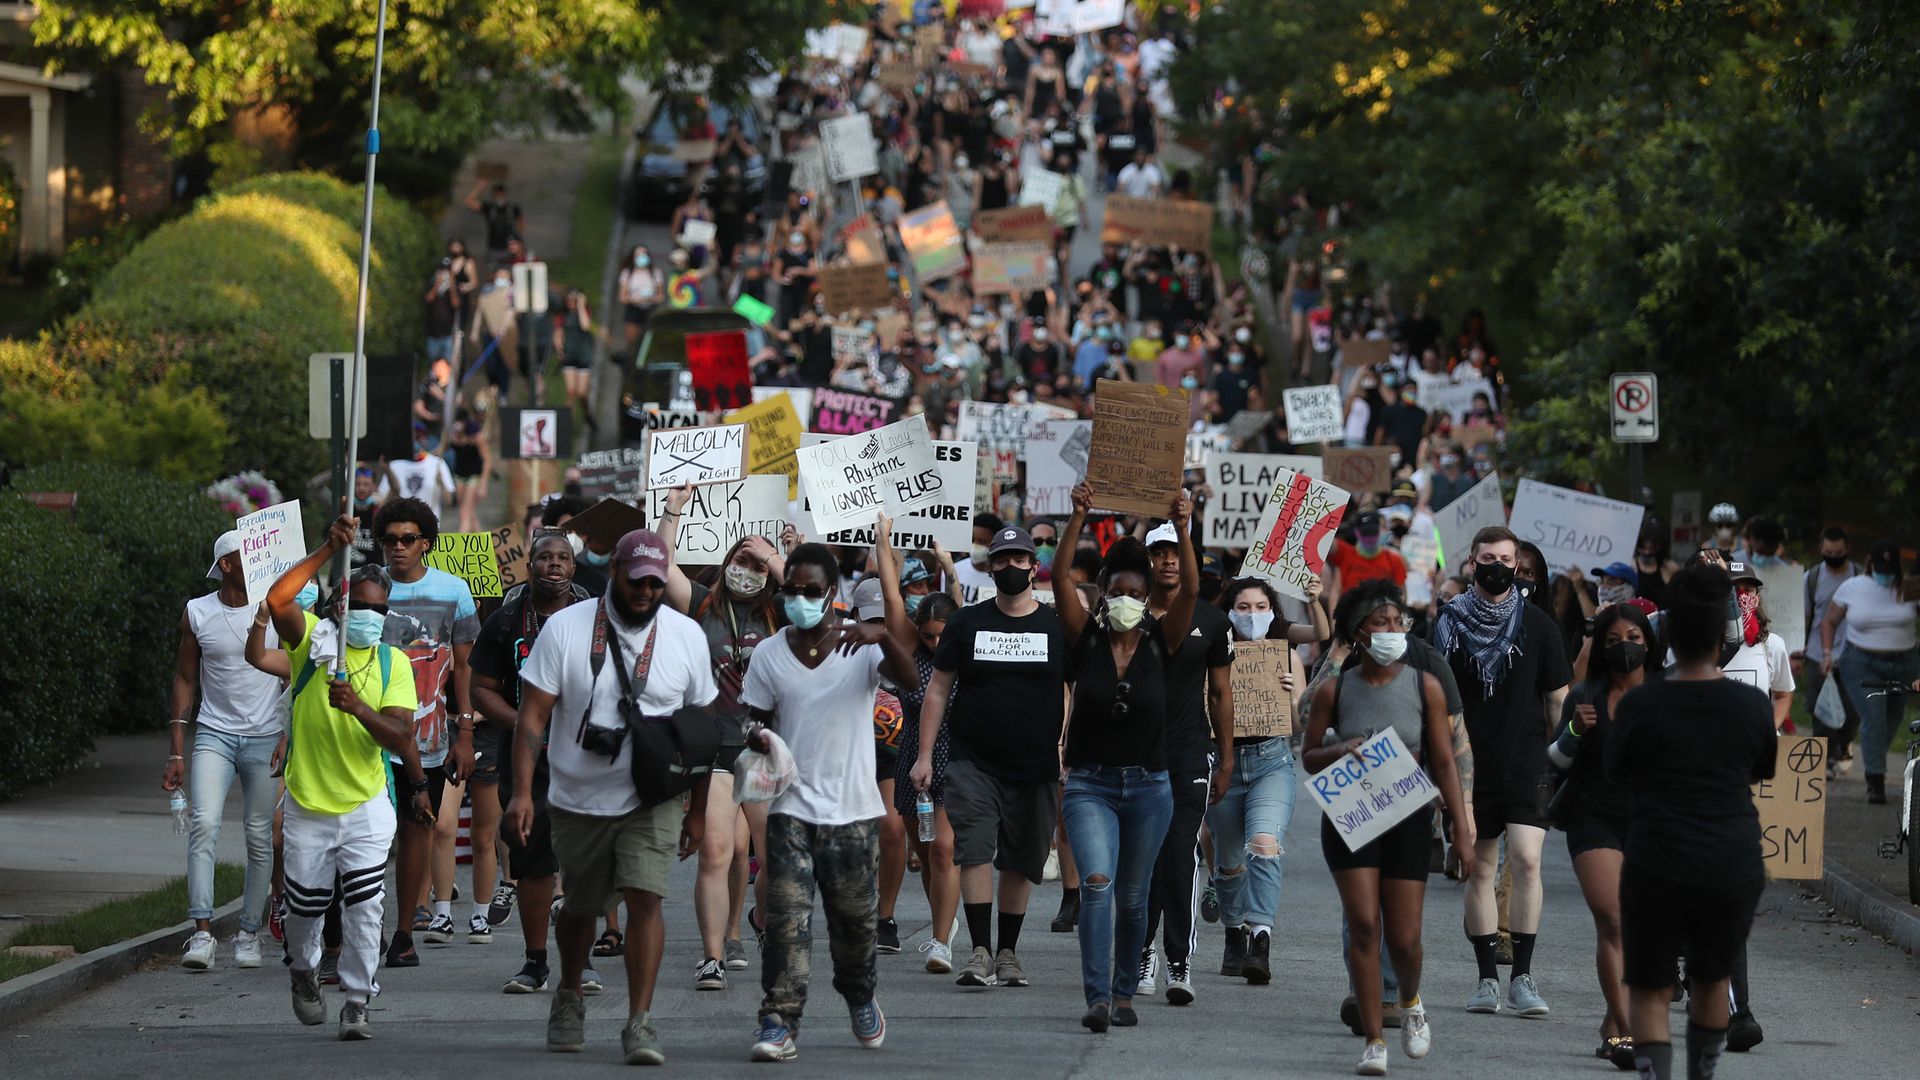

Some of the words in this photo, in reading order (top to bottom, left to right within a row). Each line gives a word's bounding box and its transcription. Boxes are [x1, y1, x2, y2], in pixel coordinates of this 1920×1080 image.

[816, 387, 893, 419] PROTECT
[653, 427, 741, 455] MALCOLM
[810, 443, 854, 467] YOU
[858, 433, 881, 460] cannot
[1164, 441, 1176, 453] BE
[650, 475, 677, 486] WAS
[699, 467, 740, 481] RIGHT
[843, 456, 906, 485] Rhythm
[1095, 462, 1114, 476] SAY
[1117, 463, 1144, 480] THEIR
[1145, 468, 1177, 482] NAMES
[831, 485, 883, 513] IGNORE
[895, 468, 943, 503] BLUES
[1286, 475, 1329, 499] LOVE
[1222, 491, 1268, 512] LIV
[1274, 484, 1335, 515] BLACK
[1456, 494, 1480, 528] NO
[238, 510, 286, 530] Breathing
[1268, 494, 1339, 530] PEOPLE
[1278, 510, 1313, 532] LIKE
[1213, 517, 1260, 540] MAT
[1280, 523, 1304, 542] YOU
[1528, 519, 1613, 557] STAND
[243, 529, 281, 555] RIGHT,
[461, 534, 489, 553] YOU
[1265, 532, 1309, 557] LOVE
[249, 553, 262, 565] not
[446, 554, 495, 576] OVER
[1252, 541, 1315, 573] BLACK
[975, 648, 1012, 656] BLACK
[1259, 644, 1280, 659] YOU
[1235, 661, 1266, 674] WHAT
[1275, 660, 1284, 673] A
[1251, 689, 1276, 703] THIS
[1265, 702, 1279, 715] IS
[1312, 736, 1398, 804] Racism
[1335, 800, 1374, 834] small
[1370, 787, 1394, 813] dick
[1392, 767, 1432, 798] energy
[1795, 778, 1823, 803] IS
